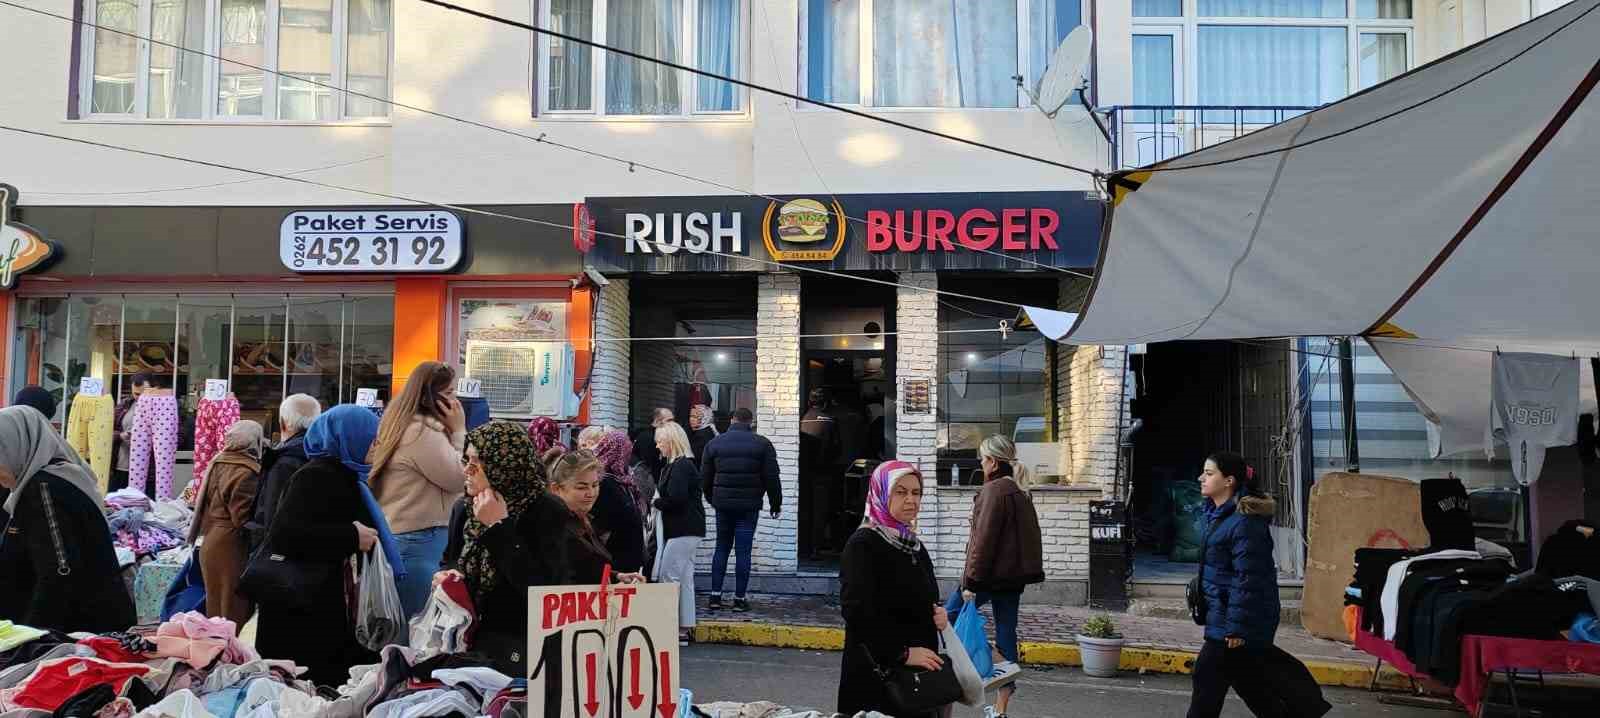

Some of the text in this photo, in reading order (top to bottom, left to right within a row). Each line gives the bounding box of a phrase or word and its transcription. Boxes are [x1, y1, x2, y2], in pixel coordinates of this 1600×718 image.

[294, 213, 448, 231] Paket Servis
[625, 211, 742, 254] RUSH
[867, 207, 1059, 252] BURGER
[293, 235, 306, 268] 0262
[307, 236, 445, 265] 452 31 92
[530, 625, 658, 718] 100
